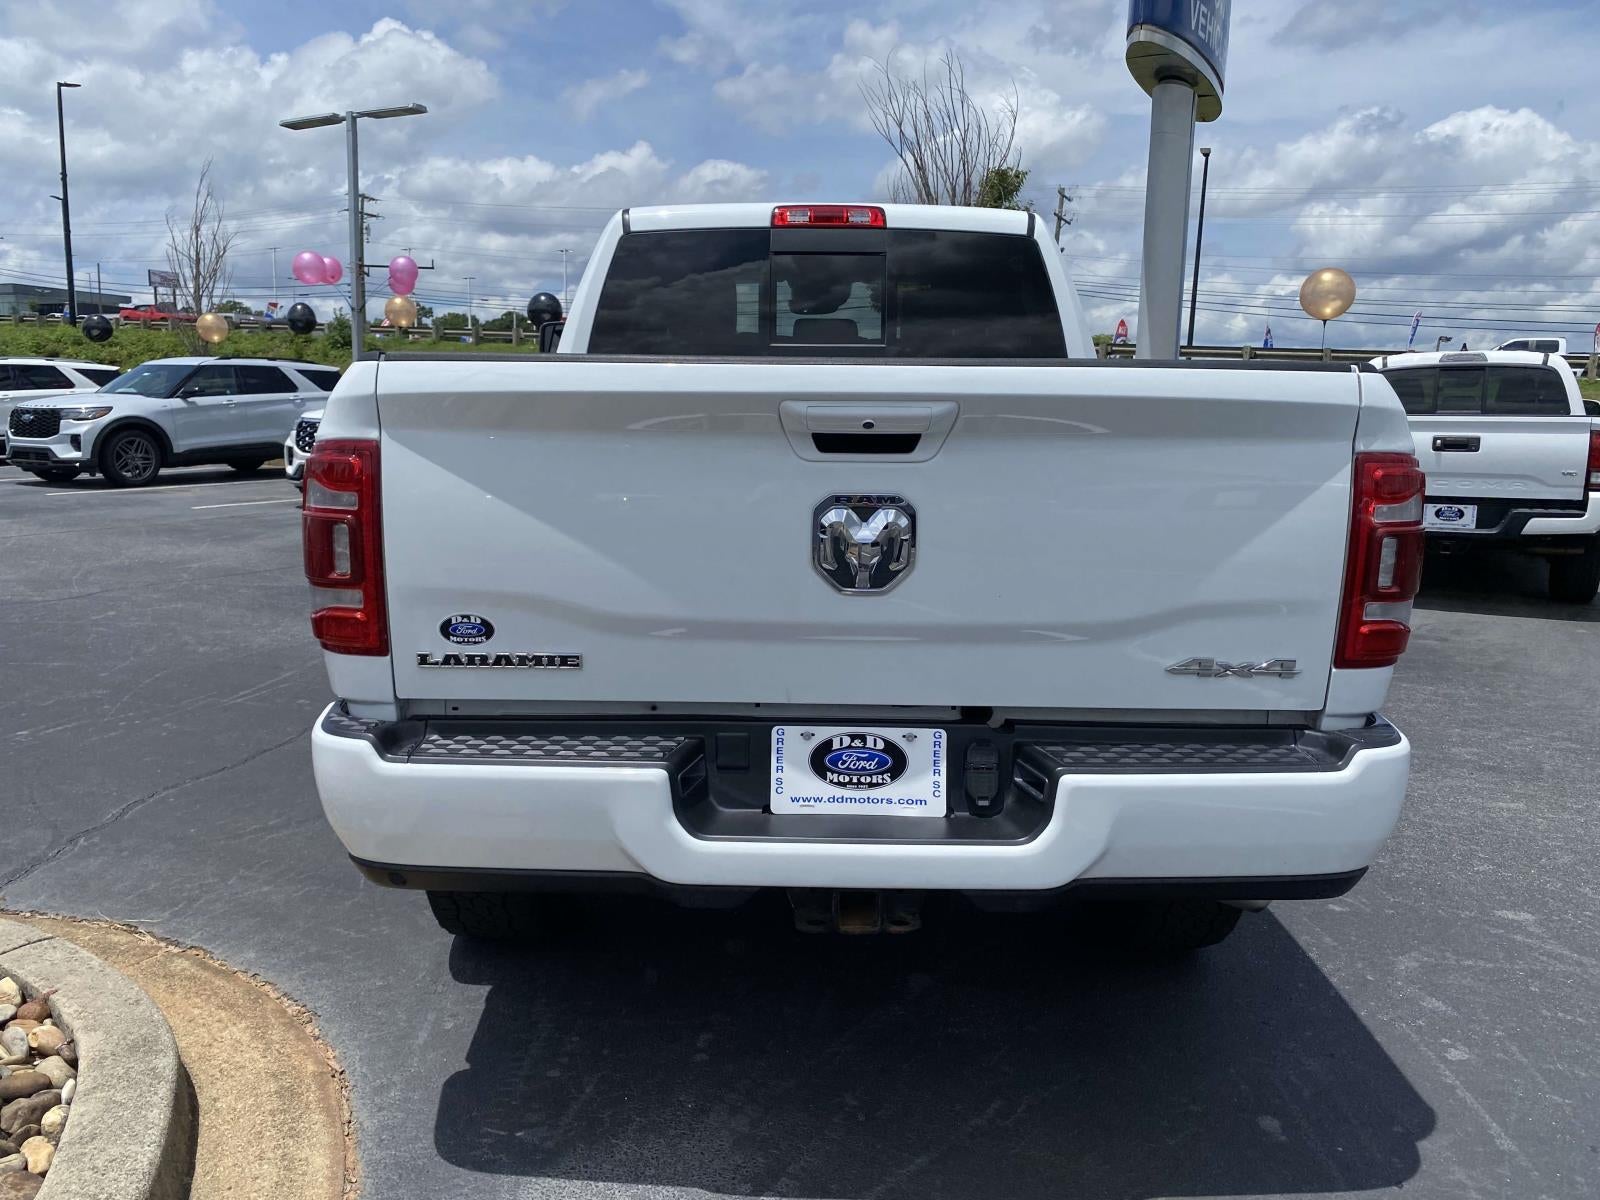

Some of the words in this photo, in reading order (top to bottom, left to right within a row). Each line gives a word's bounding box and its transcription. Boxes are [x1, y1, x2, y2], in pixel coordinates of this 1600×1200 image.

[1431, 479, 1528, 490] COMA
[451, 615, 482, 625] D&D
[456, 625, 479, 635] Ford
[416, 651, 583, 670] LARAMIE
[776, 728, 785, 774] GREER
[831, 735, 886, 751] D&D
[837, 752, 878, 770] Ford
[933, 730, 942, 777] GREER
[775, 777, 784, 795] SC
[826, 771, 892, 785] MOTORS
[932, 780, 942, 798] SC
[790, 795, 928, 807] www.ddmotors.com
